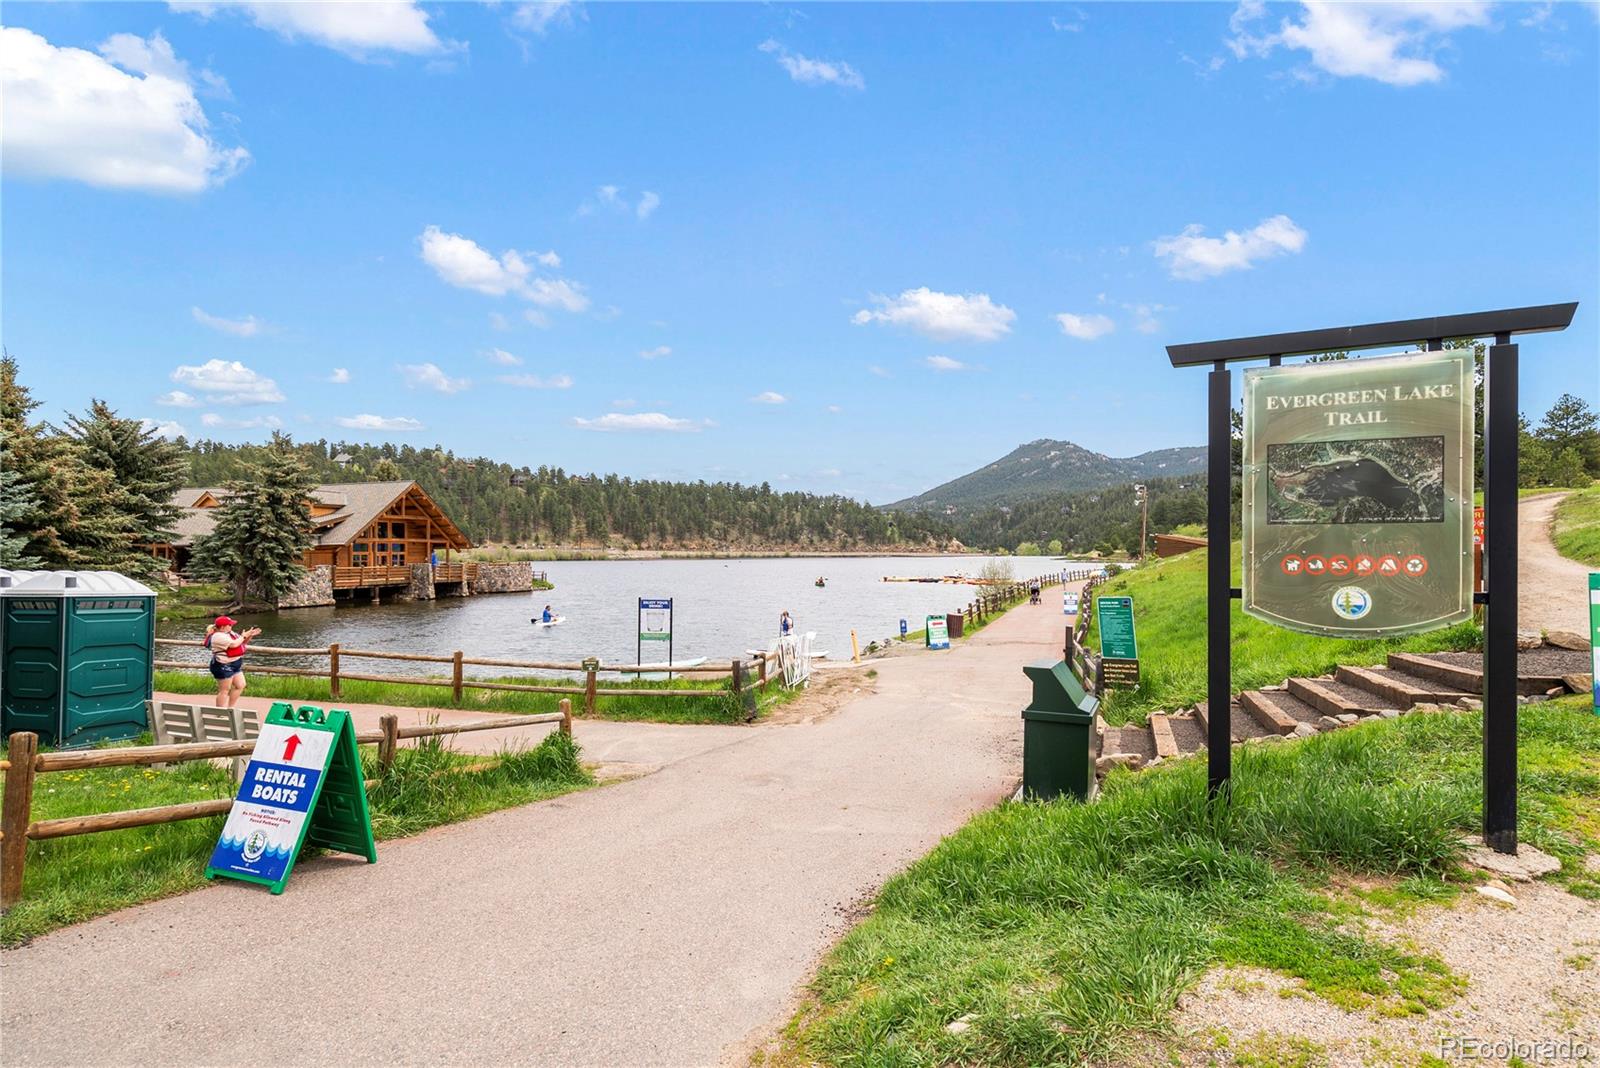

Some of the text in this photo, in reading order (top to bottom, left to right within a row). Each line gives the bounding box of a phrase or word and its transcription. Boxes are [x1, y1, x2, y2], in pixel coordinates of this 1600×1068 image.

[1265, 383, 1455, 411] EVERGREEN LAKE
[1324, 410, 1389, 427] TRAIL
[254, 767, 306, 788] RENTAL
[251, 784, 299, 804] BOATS
